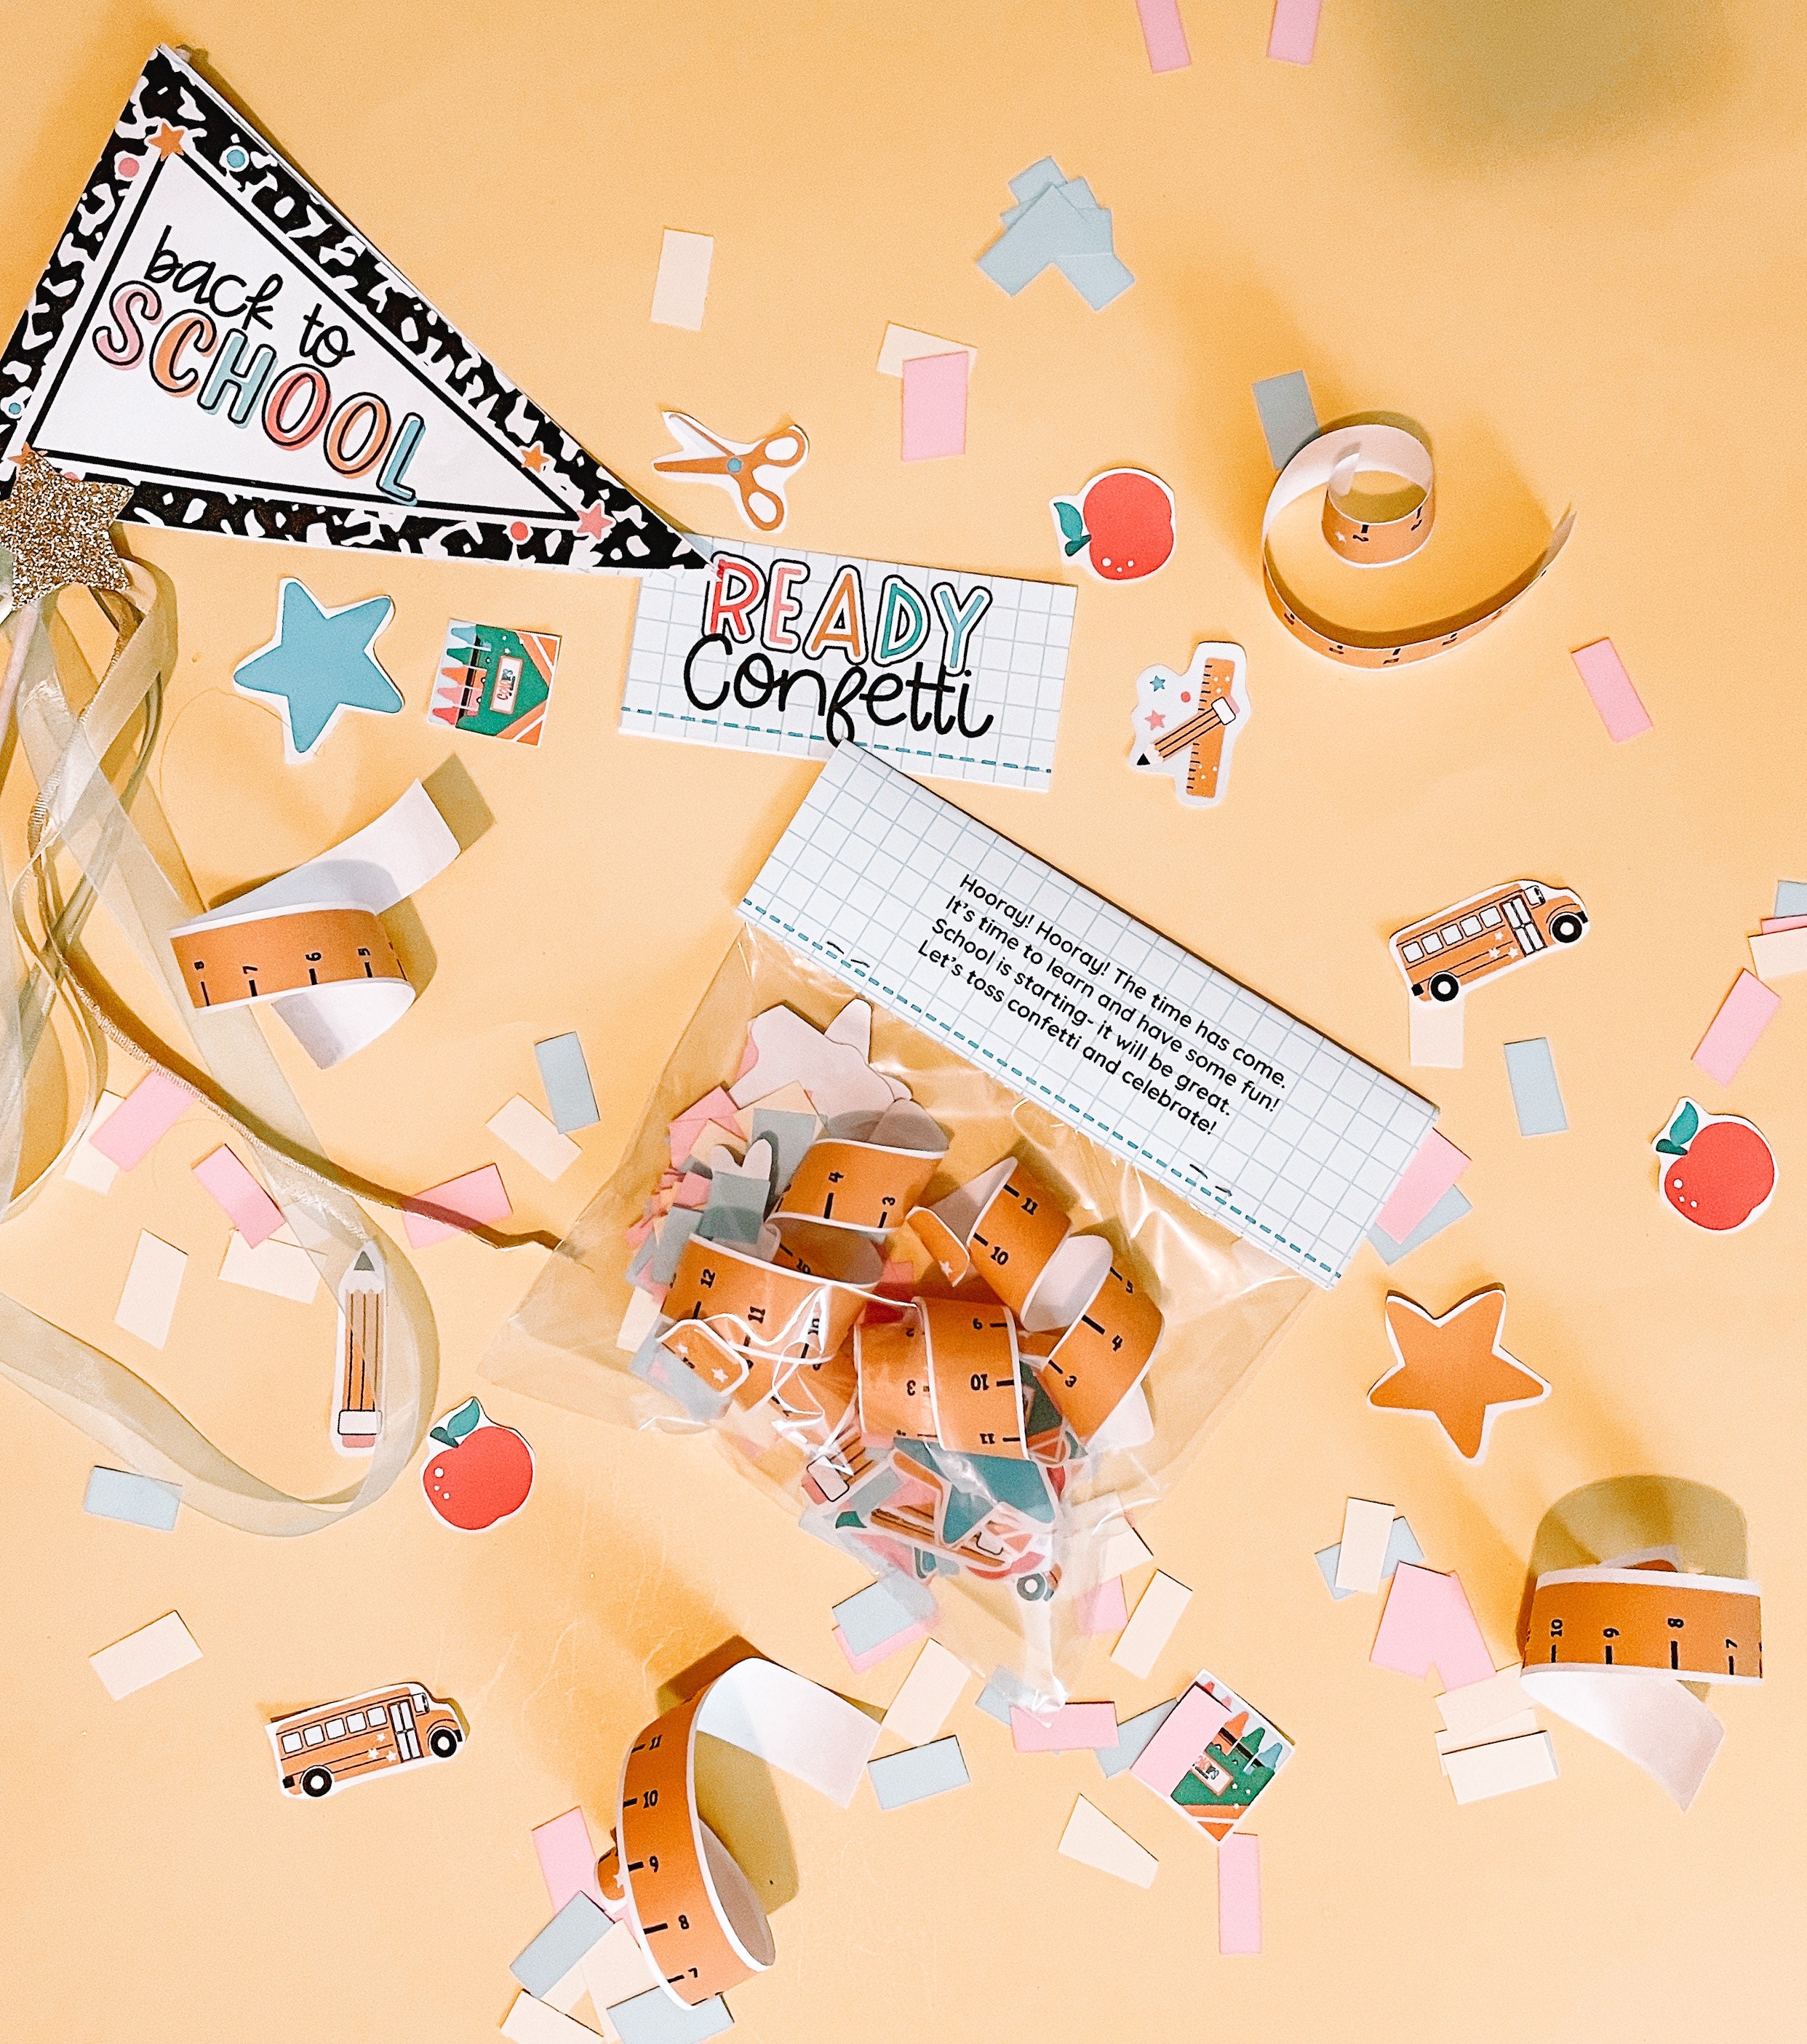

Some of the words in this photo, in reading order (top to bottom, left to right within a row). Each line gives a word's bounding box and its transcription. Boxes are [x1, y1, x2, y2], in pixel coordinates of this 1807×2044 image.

[143, 224, 284, 331] back
[299, 303, 356, 369] to
[92, 279, 427, 506] SCHOOL
[701, 550, 994, 676] READY
[684, 632, 994, 748] Confetti
[305, 952, 322, 962] 6
[357, 947, 371, 957] 5
[242, 965, 258, 975] 7
[960, 874, 1035, 928] Hooray!
[1035, 921, 1111, 976] Hooray!
[1114, 967, 1146, 999] The
[1151, 994, 1192, 1028] time
[1194, 1019, 1230, 1051] has
[1232, 1047, 1285, 1089] come.
[945, 895, 976, 922] It's
[978, 917, 1019, 950] time
[1023, 944, 1043, 965] to
[1046, 957, 1094, 998] learn
[1098, 994, 1138, 1023] and
[1136, 1014, 1182, 1053] have
[1185, 1048, 1237, 1087] some
[1240, 1079, 1280, 1109] fun!
[932, 918, 996, 965] School
[996, 960, 1013, 976] is
[1013, 972, 1094, 1026] starting-
[1097, 1020, 1113, 1040] it
[1116, 1034, 1149, 1061] will
[1148, 1052, 1173, 1077] be
[1174, 1074, 1230, 1116] great.
[917, 939, 963, 976] Let's
[966, 970, 1005, 1002] toss
[1008, 999, 1082, 1050] confetti
[1082, 1046, 1122, 1075] and
[1122, 1071, 1217, 1135] celebrate!
[828, 1171, 845, 1183] 4
[882, 1197, 896, 1206] 3
[1021, 1196, 1040, 1216] 11
[990, 1246, 1010, 1266] 10
[700, 1269, 716, 1289] 12
[1125, 1280, 1134, 1294] 5
[747, 1306, 766, 1324] 11
[1112, 1334, 1123, 1352] 4
[906, 1379, 917, 1397] 3
[970, 1373, 989, 1391] 10
[1064, 1375, 1077, 1388] 3
[979, 1433, 995, 1445] 11
[1550, 1618, 1563, 1638] 10
[1603, 1627, 1620, 1638] 9
[1667, 1618, 1685, 1629] 8
[1725, 1638, 1738, 1649] 7
[648, 1733, 663, 1751] 11
[642, 1789, 659, 1809] 10
[649, 1855, 659, 1873] 9
[678, 1914, 690, 1930] 8
[687, 1967, 698, 1979] 7
